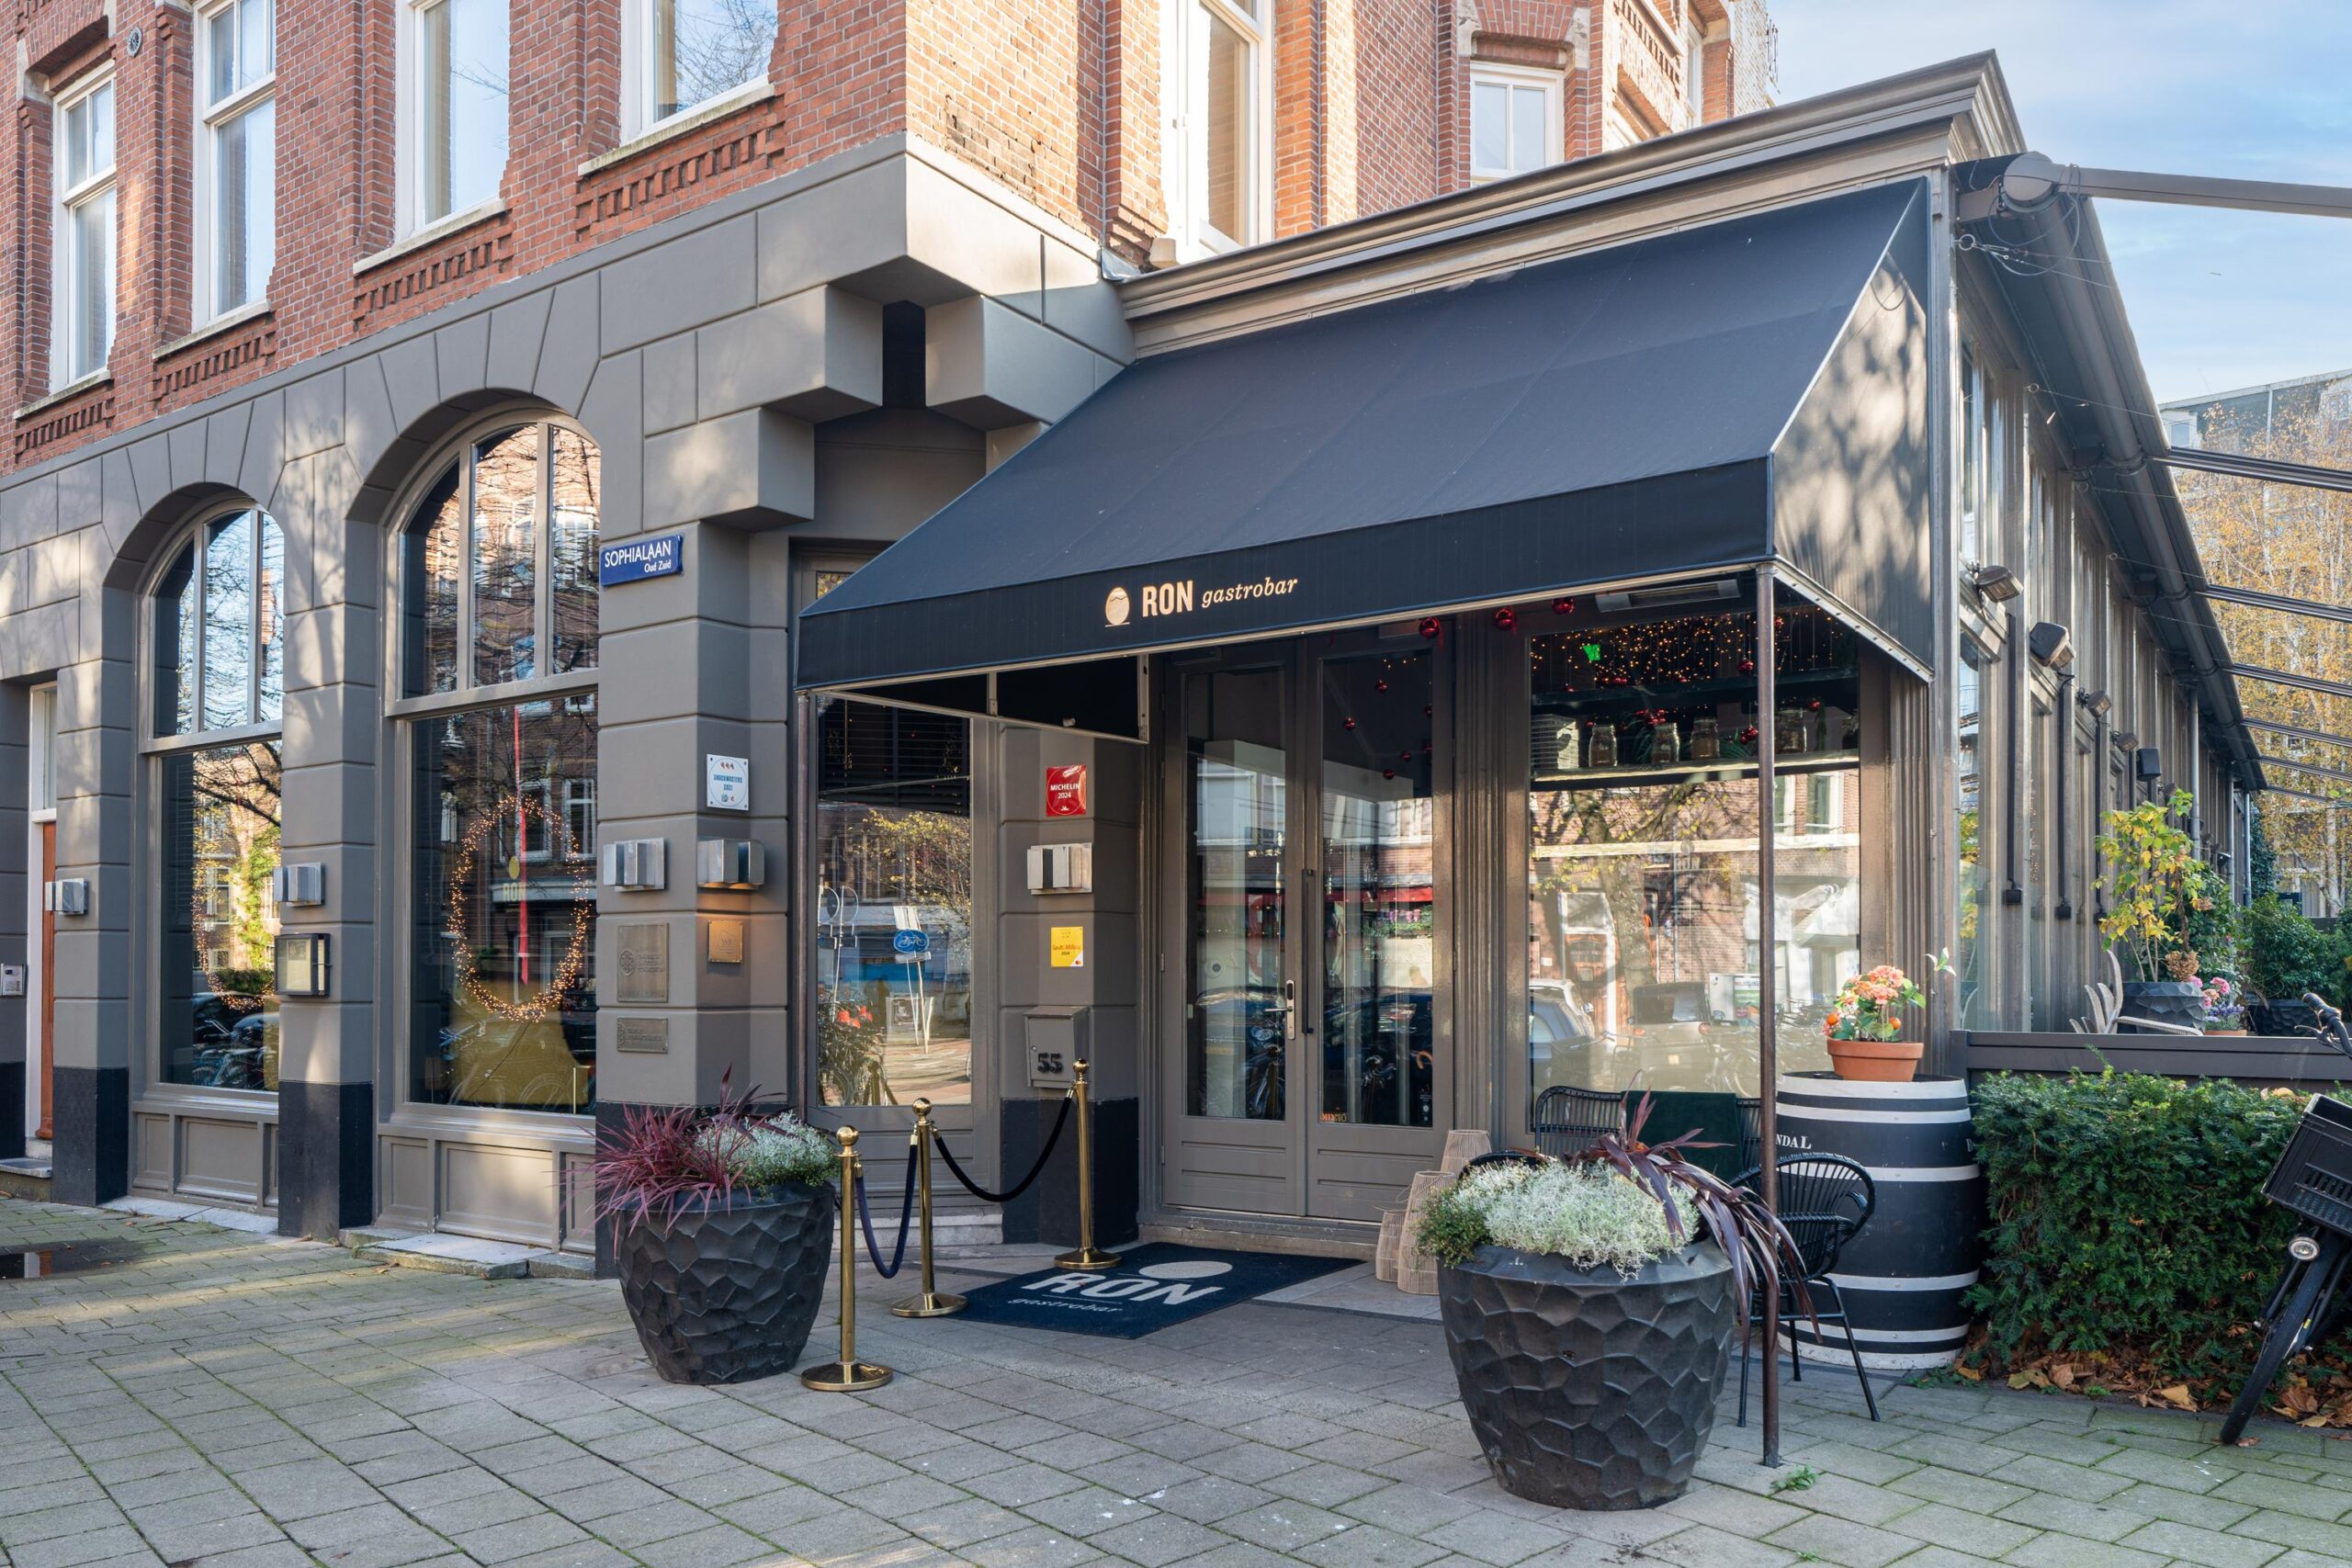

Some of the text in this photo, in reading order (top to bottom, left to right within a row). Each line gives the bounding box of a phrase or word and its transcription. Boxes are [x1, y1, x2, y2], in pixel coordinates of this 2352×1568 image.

[605, 540, 672, 568] SOPHIALAAN
[644, 559, 672, 573] Oud Zuid
[1142, 576, 1298, 618] RON gastrobar
[1050, 783, 1080, 791] MICHELIN
[1037, 1052, 1063, 1074] 55
[1775, 1134, 1812, 1149] NDAL
[1020, 1271, 1225, 1305] RON
[1007, 1297, 1124, 1314] gastrobar
